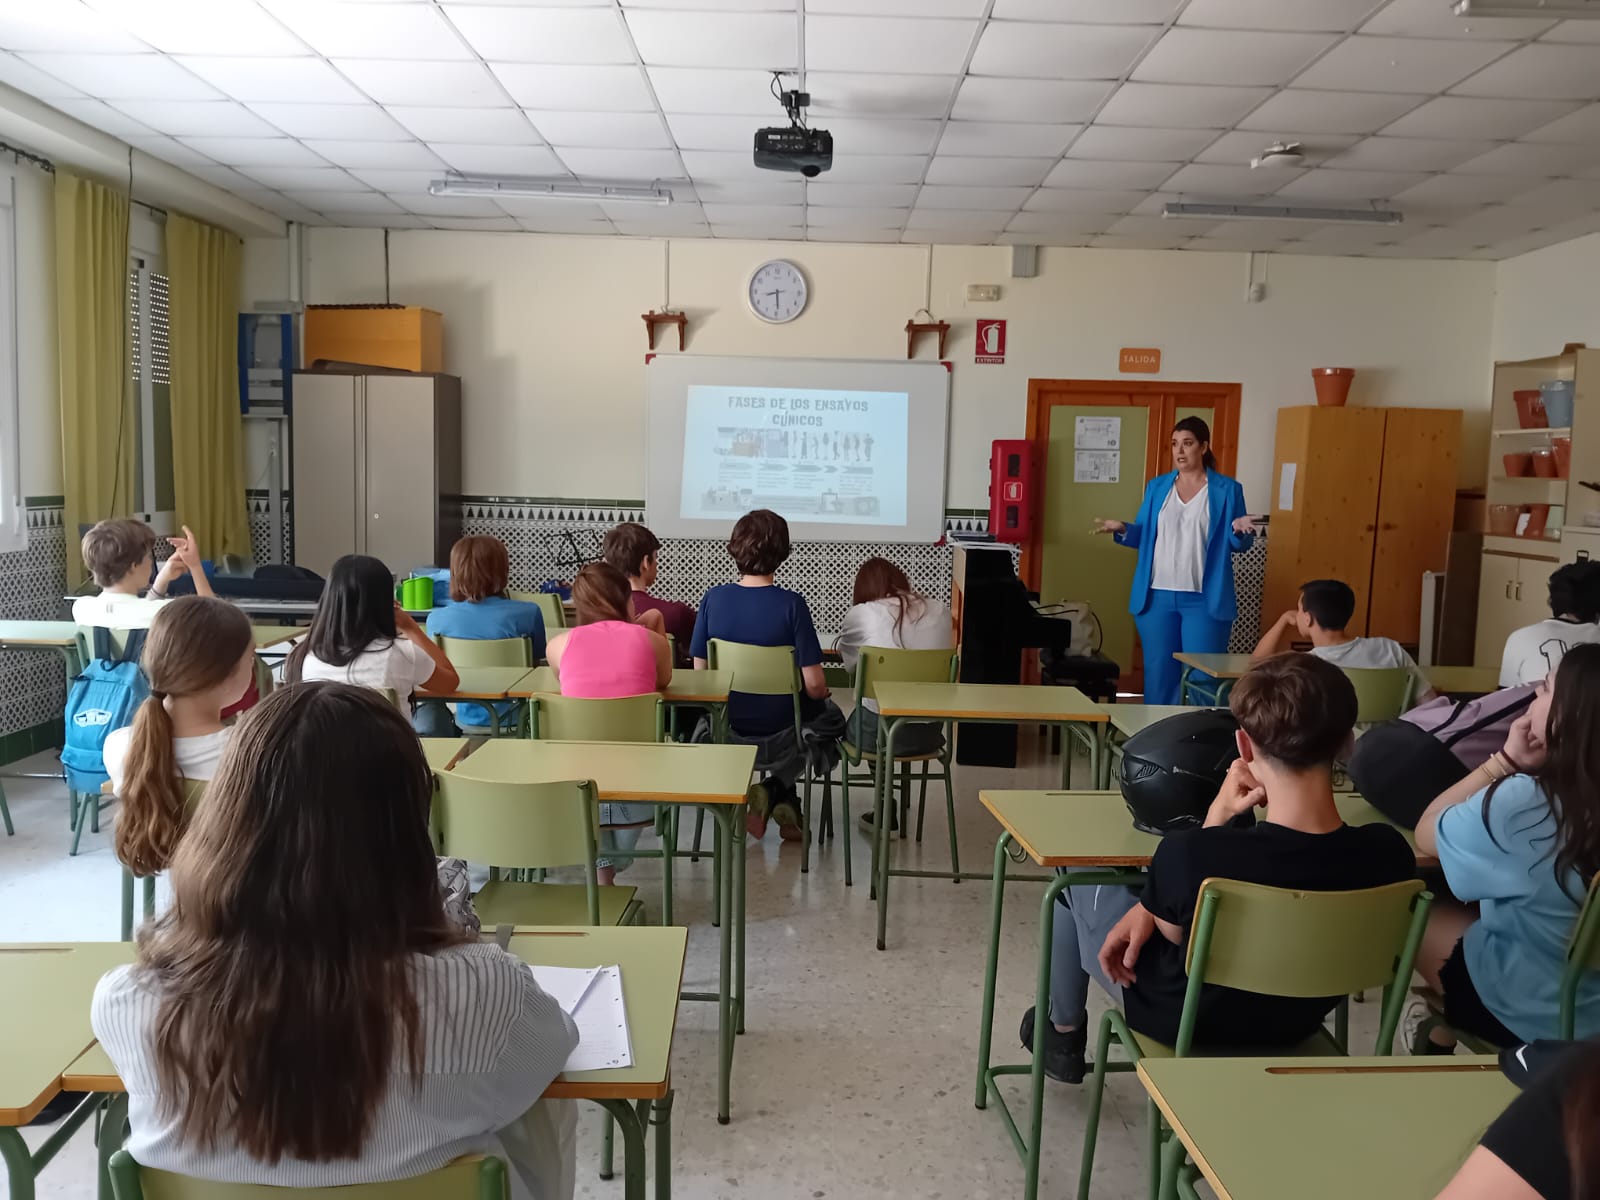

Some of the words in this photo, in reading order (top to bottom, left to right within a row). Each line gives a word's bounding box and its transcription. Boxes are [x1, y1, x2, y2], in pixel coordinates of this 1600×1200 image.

[1123, 354, 1156, 364] SALIDA
[728, 396, 766, 409] FASES
[770, 398, 787, 410] DE
[790, 399, 810, 411] LOS
[814, 398, 869, 412] ENSAYOS
